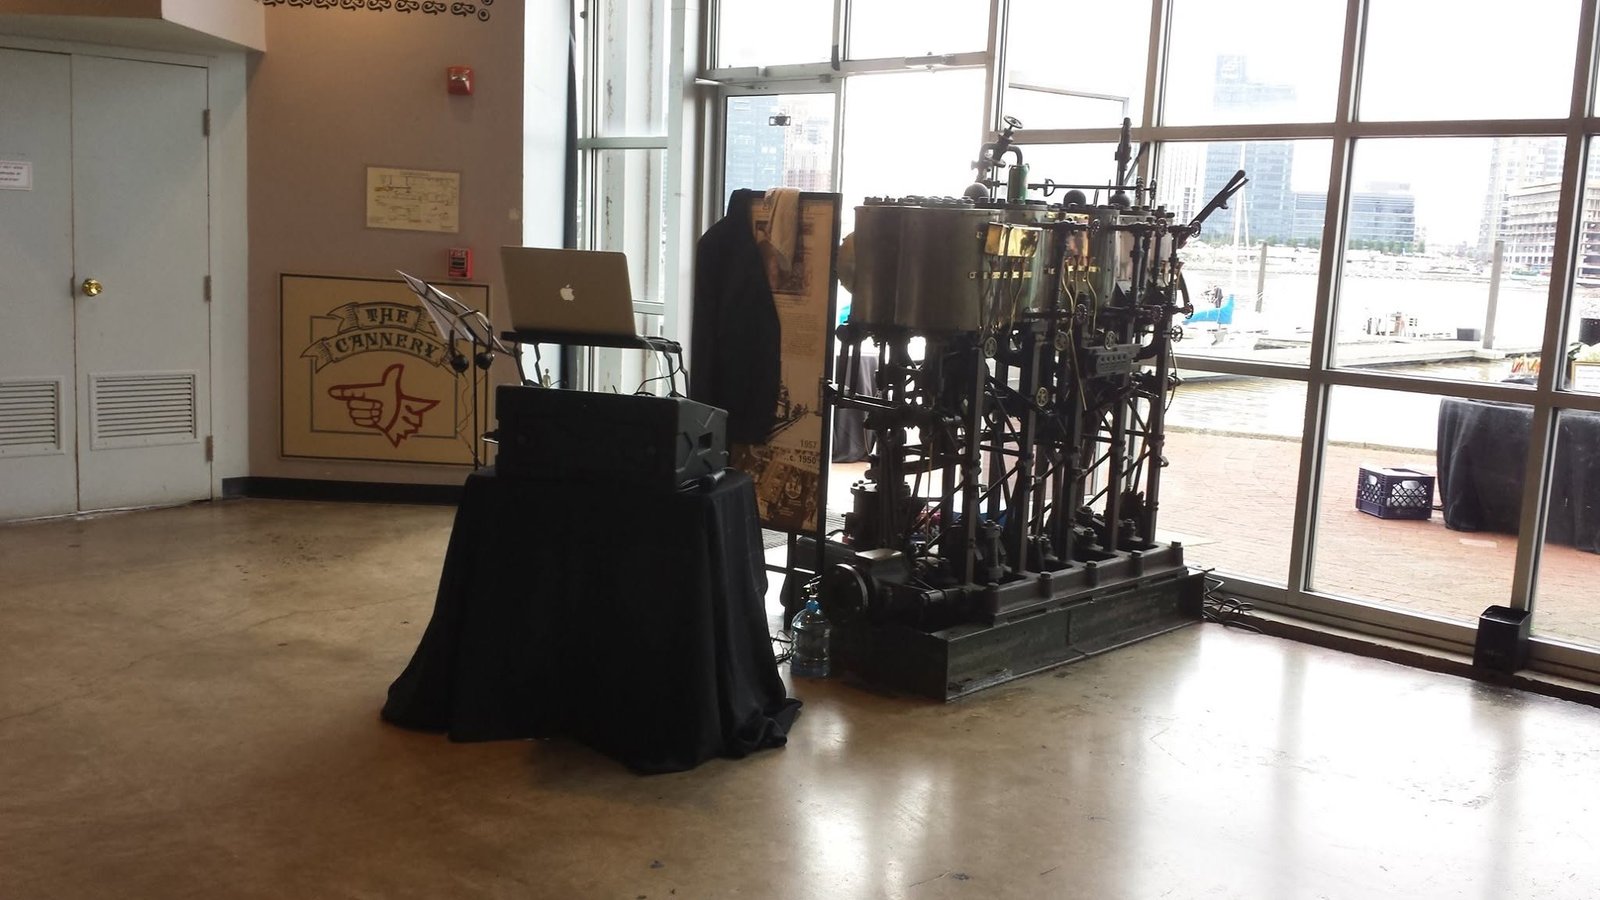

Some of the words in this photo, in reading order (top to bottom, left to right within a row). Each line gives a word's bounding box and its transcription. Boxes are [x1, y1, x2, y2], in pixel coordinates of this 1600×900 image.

[367, 308, 409, 324] THE
[336, 333, 439, 358] CANNERY
[799, 455, 817, 464] 1950
